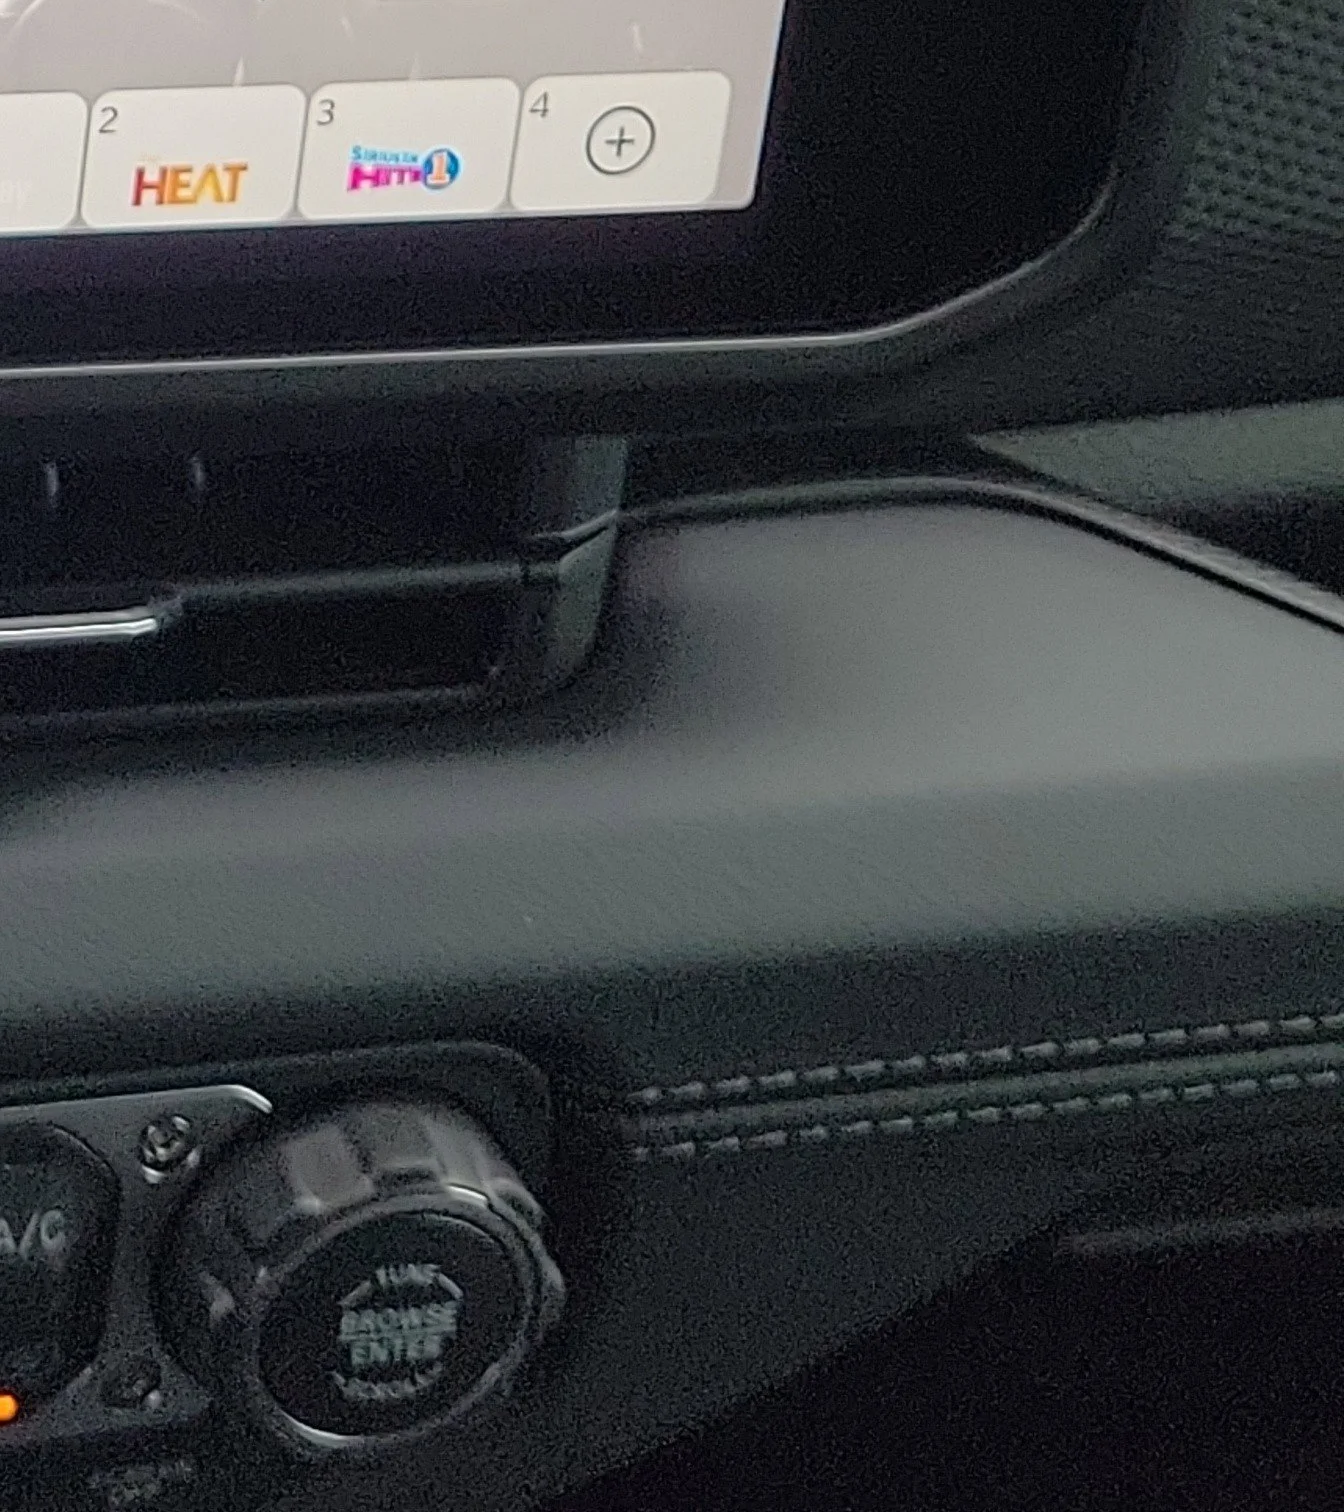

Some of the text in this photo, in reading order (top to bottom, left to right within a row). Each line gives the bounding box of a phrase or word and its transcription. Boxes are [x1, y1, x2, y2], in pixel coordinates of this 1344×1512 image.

[316, 99, 336, 126] 3
[529, 91, 550, 119] 4
[98, 106, 119, 134] 2
[131, 162, 249, 207] HEAT
